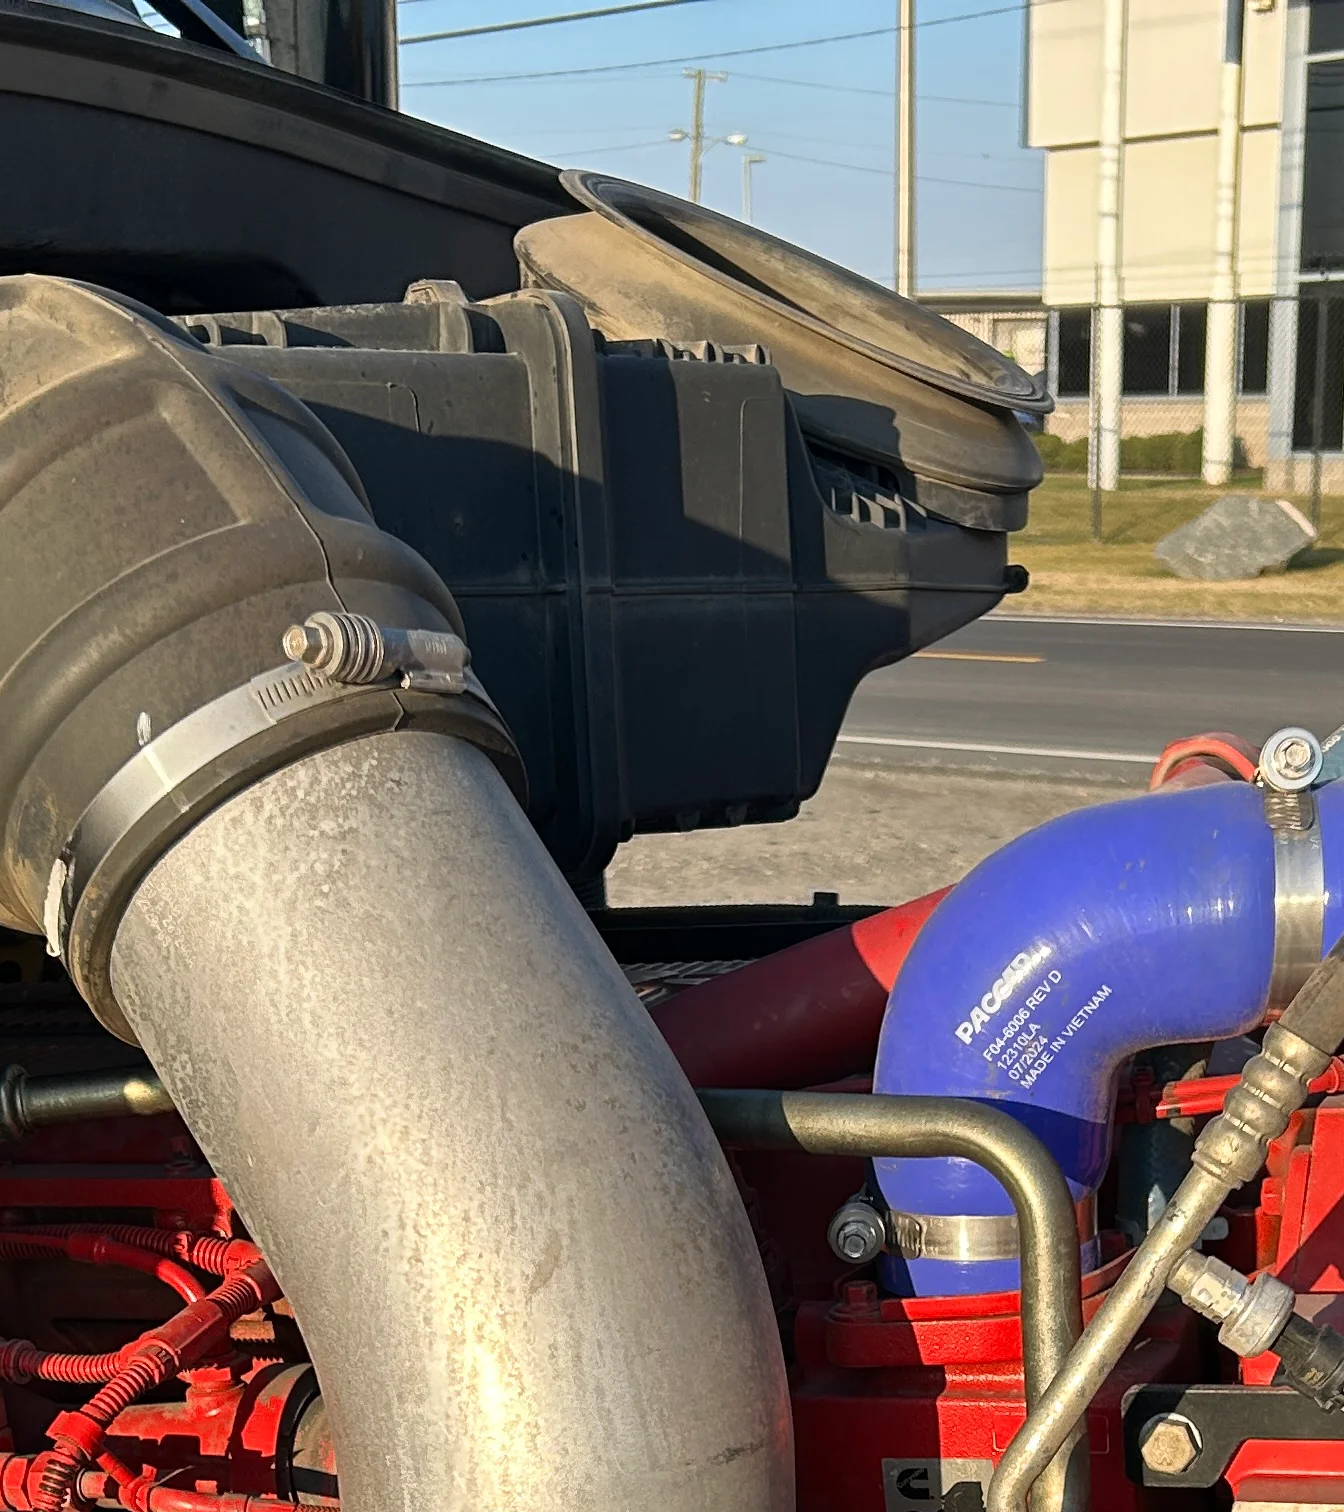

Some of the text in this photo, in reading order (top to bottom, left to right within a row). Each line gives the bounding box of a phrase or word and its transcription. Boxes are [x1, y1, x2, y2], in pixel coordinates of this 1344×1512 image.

[983, 969, 1063, 1062] F04-6006 REV D
[997, 1022, 1041, 1071] 12310LA
[1020, 984, 1113, 1090] MADE IN VIETNAM
[1008, 1035, 1049, 1080] 07/2024
